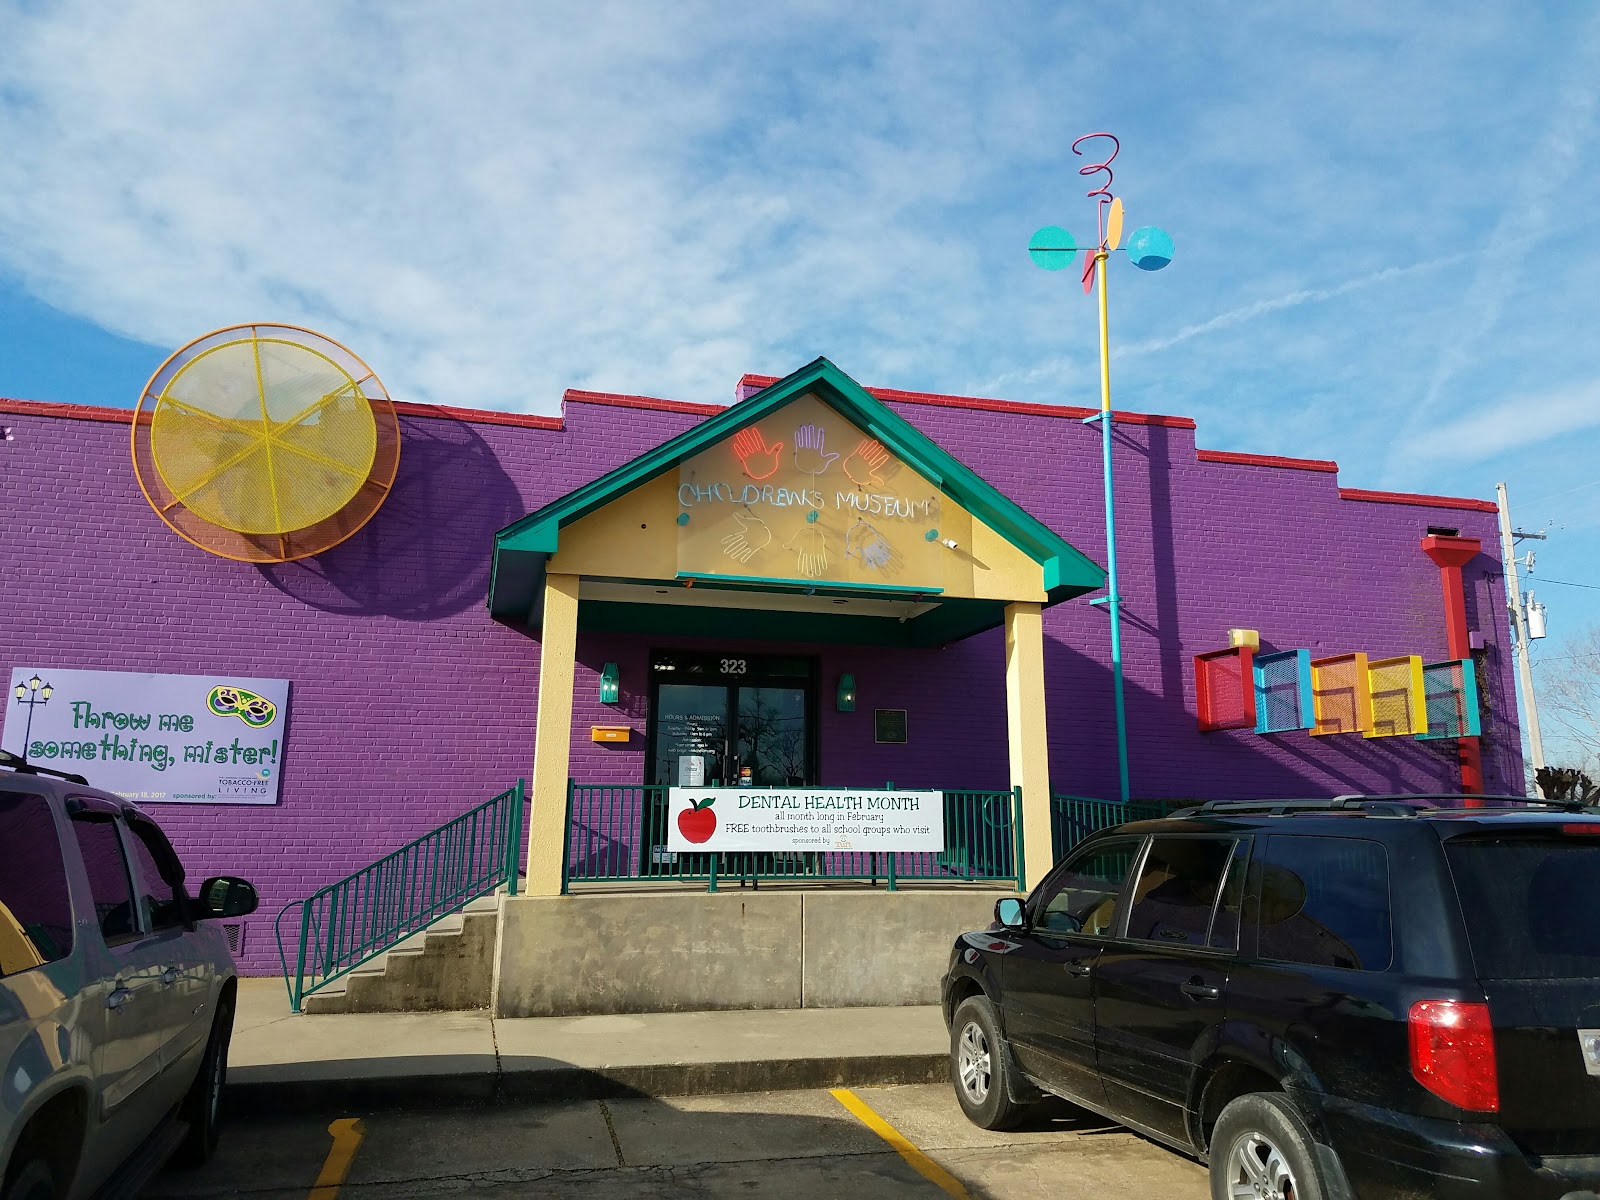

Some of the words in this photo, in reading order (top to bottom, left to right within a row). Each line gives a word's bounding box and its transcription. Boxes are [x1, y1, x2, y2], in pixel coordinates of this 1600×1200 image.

[836, 491, 932, 518] MUSEUM
[720, 658, 747, 675] 323
[70, 701, 151, 730] Throw
[159, 713, 194, 732] me
[28, 733, 176, 772] something,
[183, 738, 279, 766] mister!
[172, 792, 206, 801] sponsored
[738, 795, 801, 810] DENTAL
[804, 797, 862, 810] HEALTH
[867, 797, 920, 811] MONTH
[774, 811, 784, 821] all
[787, 812, 815, 821] month
[817, 812, 835, 823] long
[837, 813, 845, 821] in
[847, 813, 884, 823] February
[725, 823, 750, 833] FREE
[752, 823, 808, 834] toothbrushes
[810, 825, 819, 834] to
[822, 824, 831, 834] all
[833, 824, 861, 834] school
[863, 826, 891, 836] groups
[893, 825, 911, 834] who
[913, 826, 931, 835] visit
[791, 837, 821, 845] sponsored
[822, 836, 831, 846] by
